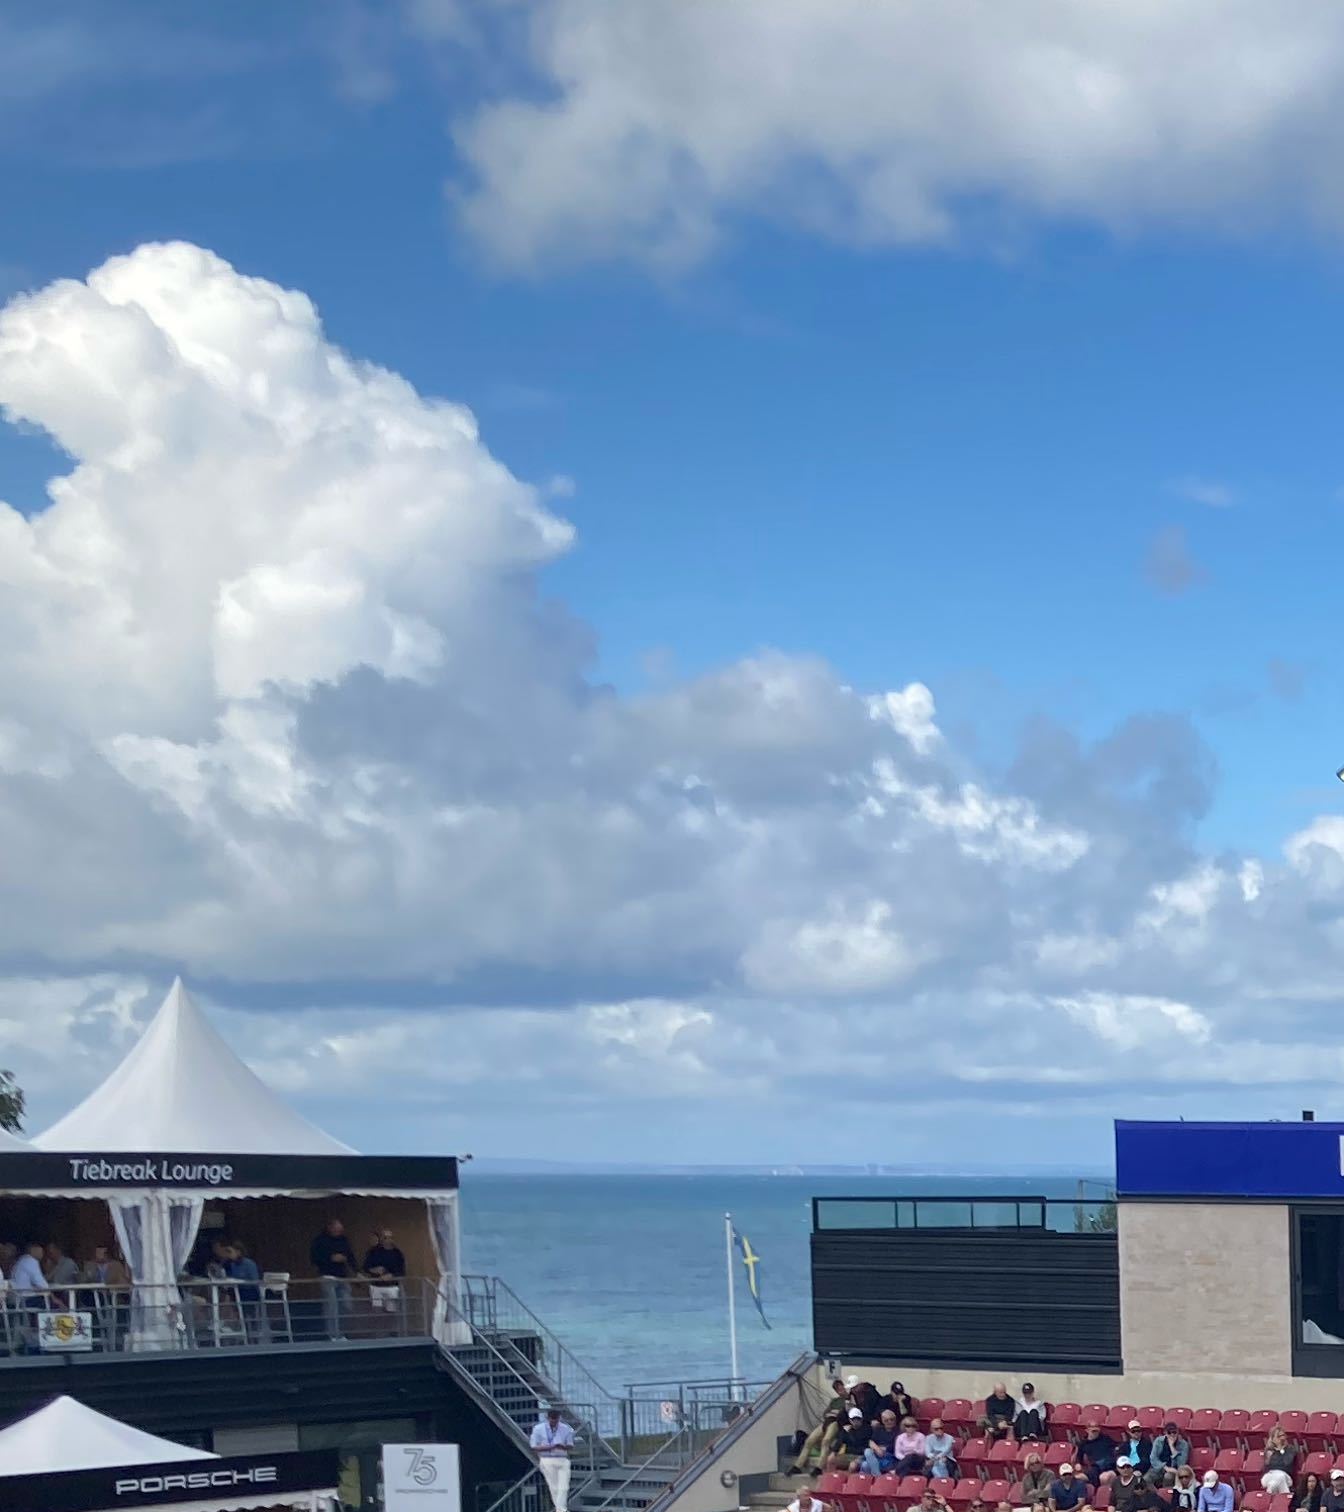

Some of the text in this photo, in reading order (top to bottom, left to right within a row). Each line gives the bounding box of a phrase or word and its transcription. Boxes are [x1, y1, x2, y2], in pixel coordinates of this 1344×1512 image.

[70, 1159, 233, 1184] Tiebreak Lounge
[116, 1467, 277, 1495] PORSCHE
[403, 1448, 437, 1486] 75
